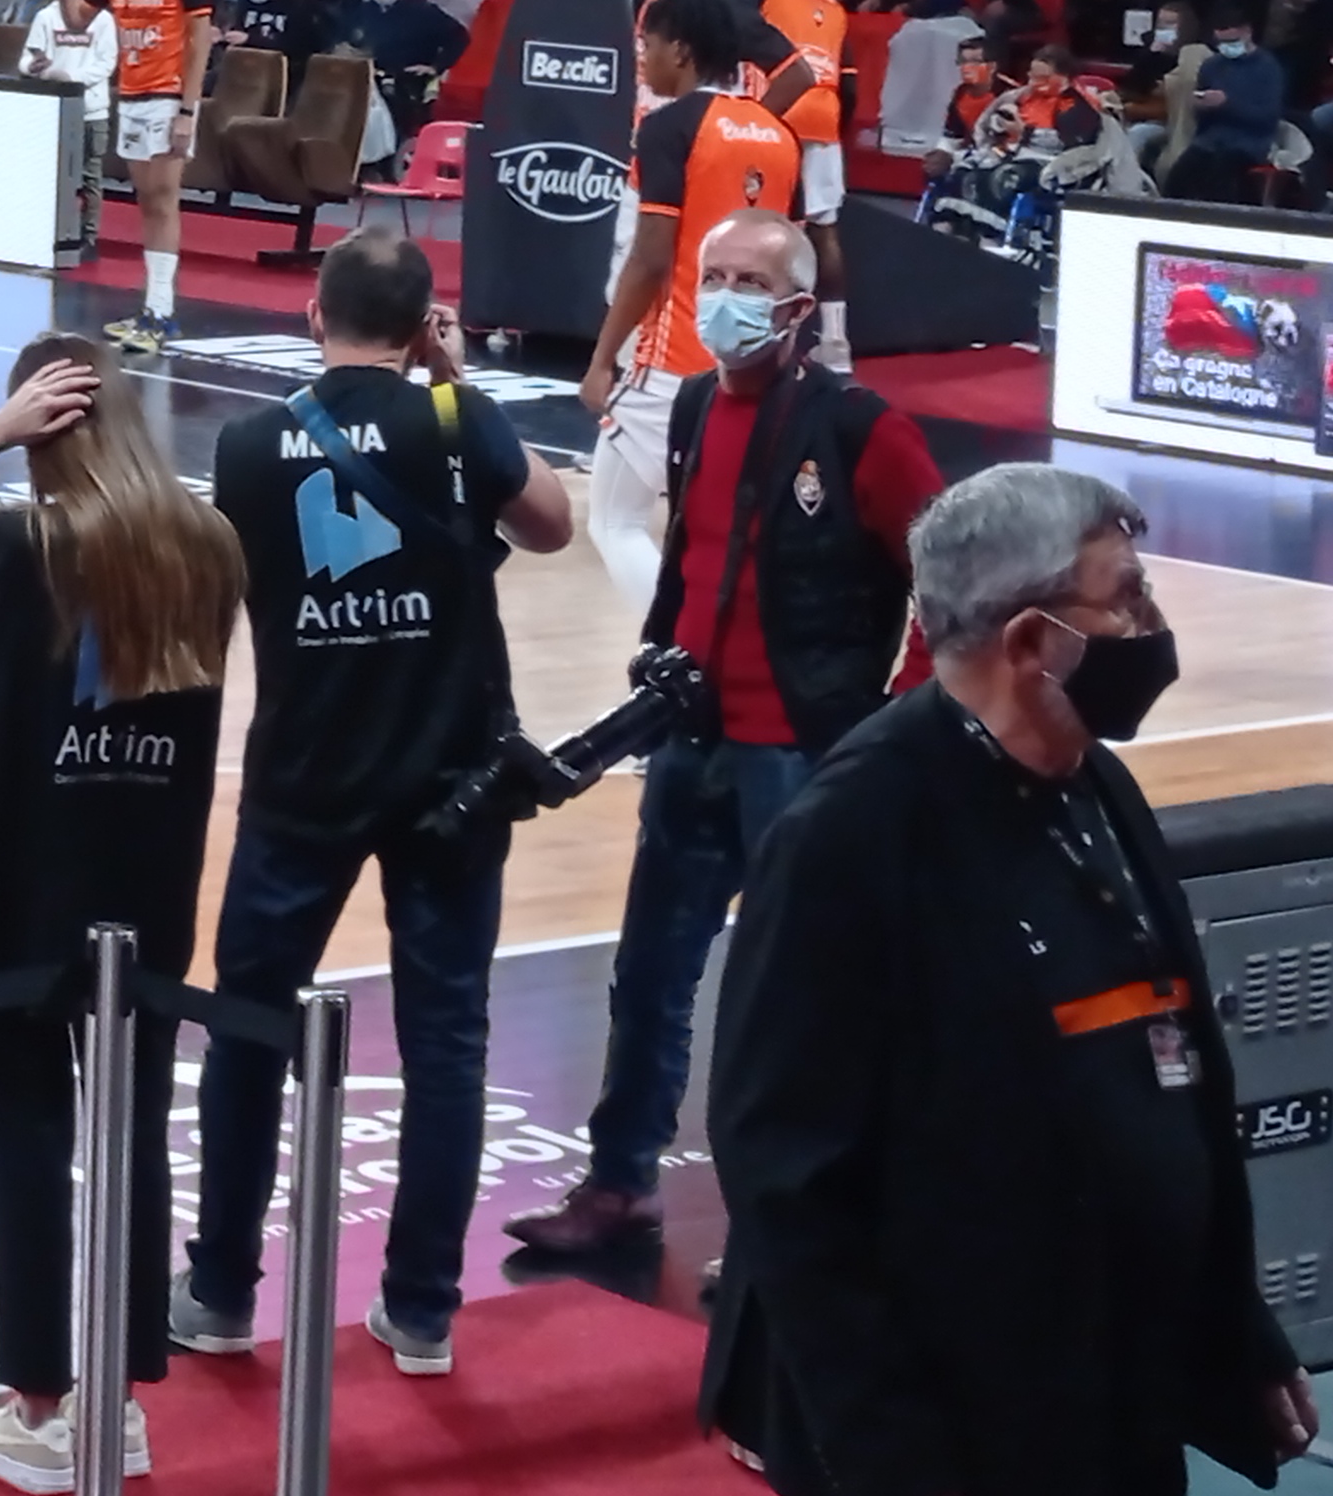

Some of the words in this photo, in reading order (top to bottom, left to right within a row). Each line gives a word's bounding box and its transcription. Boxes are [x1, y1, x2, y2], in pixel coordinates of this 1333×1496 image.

[498, 158, 516, 185] le
[517, 149, 624, 205] Gaulois
[1181, 376, 1278, 407] Catalogne
[281, 422, 387, 460] MIA
